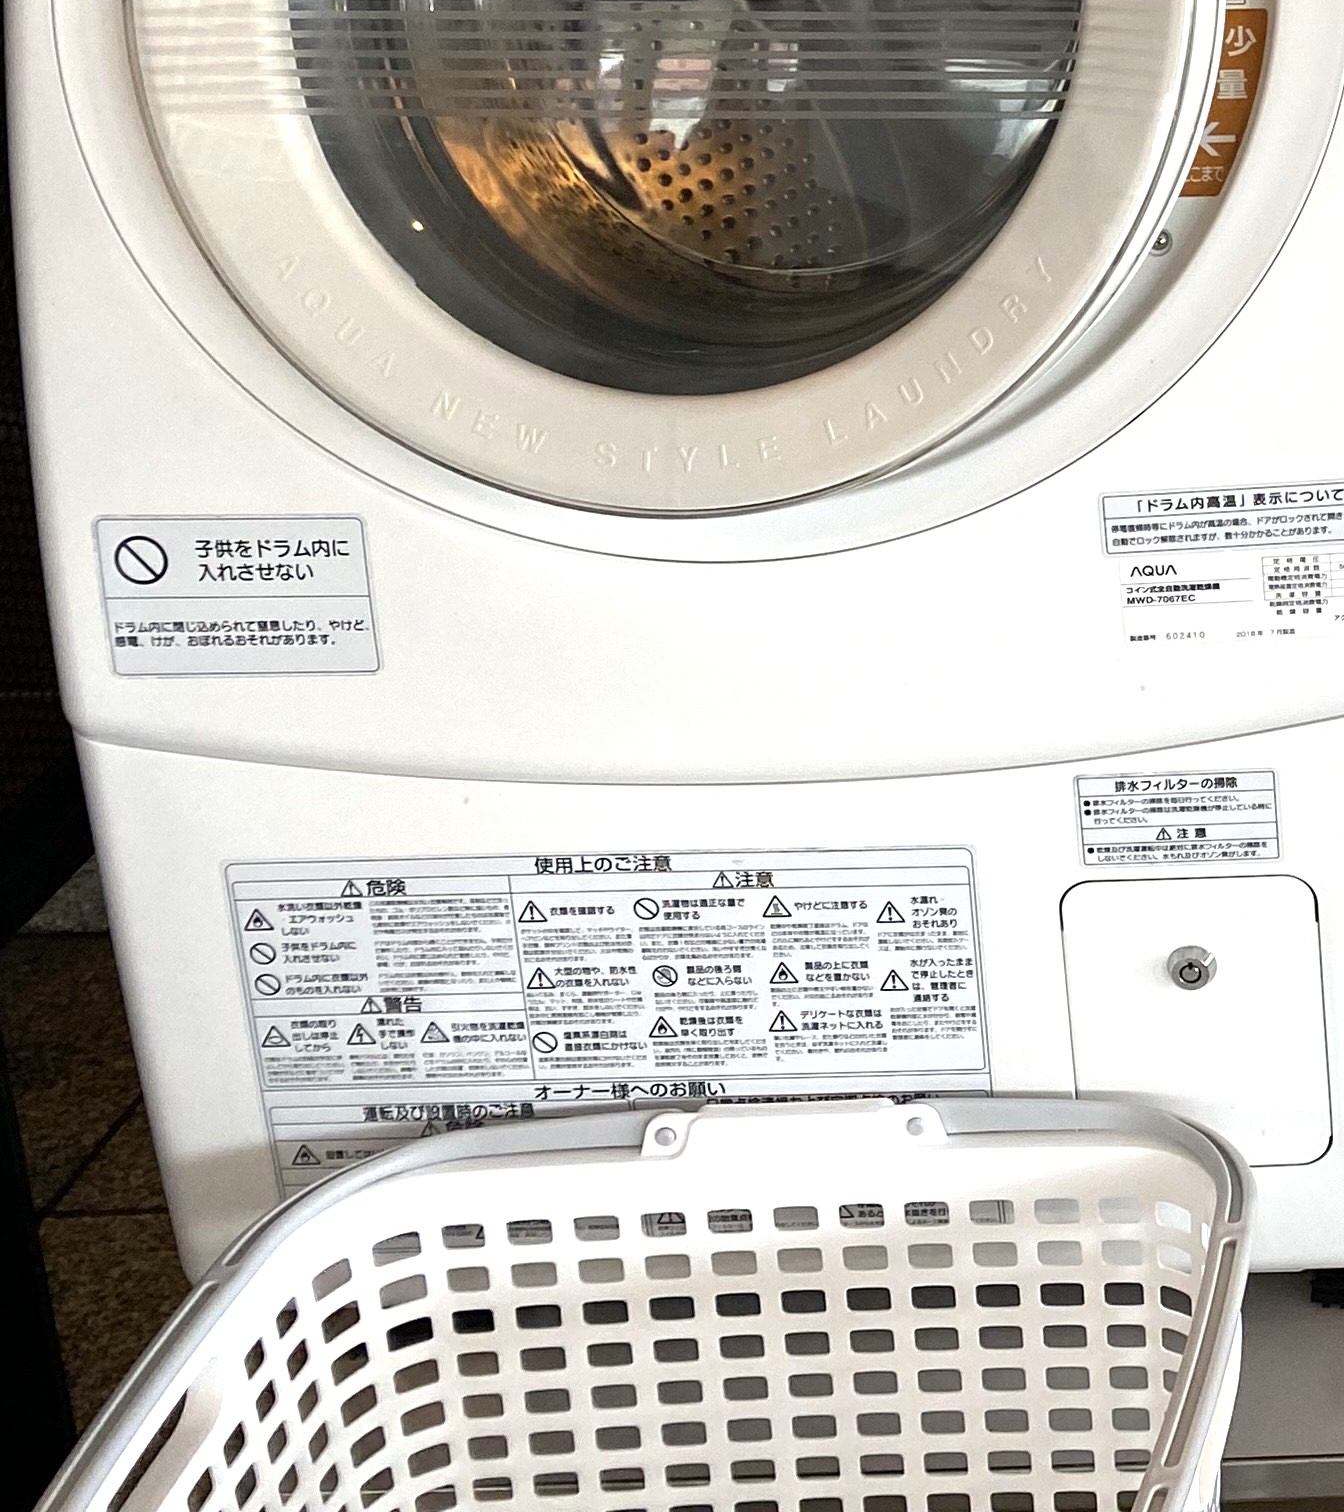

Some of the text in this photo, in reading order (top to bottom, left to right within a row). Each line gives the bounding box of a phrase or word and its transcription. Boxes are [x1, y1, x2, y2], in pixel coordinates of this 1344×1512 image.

[274, 254, 1054, 455] AQUA NEW LAUNDRY
[196, 540, 350, 558] 子供をドラム内に
[199, 564, 314, 582] 入れさせない
[1130, 565, 1177, 577] AQUA
[1127, 594, 1196, 604] MWD-7067EC
[1115, 777, 1237, 792] 排水フィルターの掃除
[535, 855, 673, 875] 使用上のご注意
[367, 880, 407, 896] 危険
[735, 871, 774, 888] 注意
[383, 996, 422, 1013] 警告
